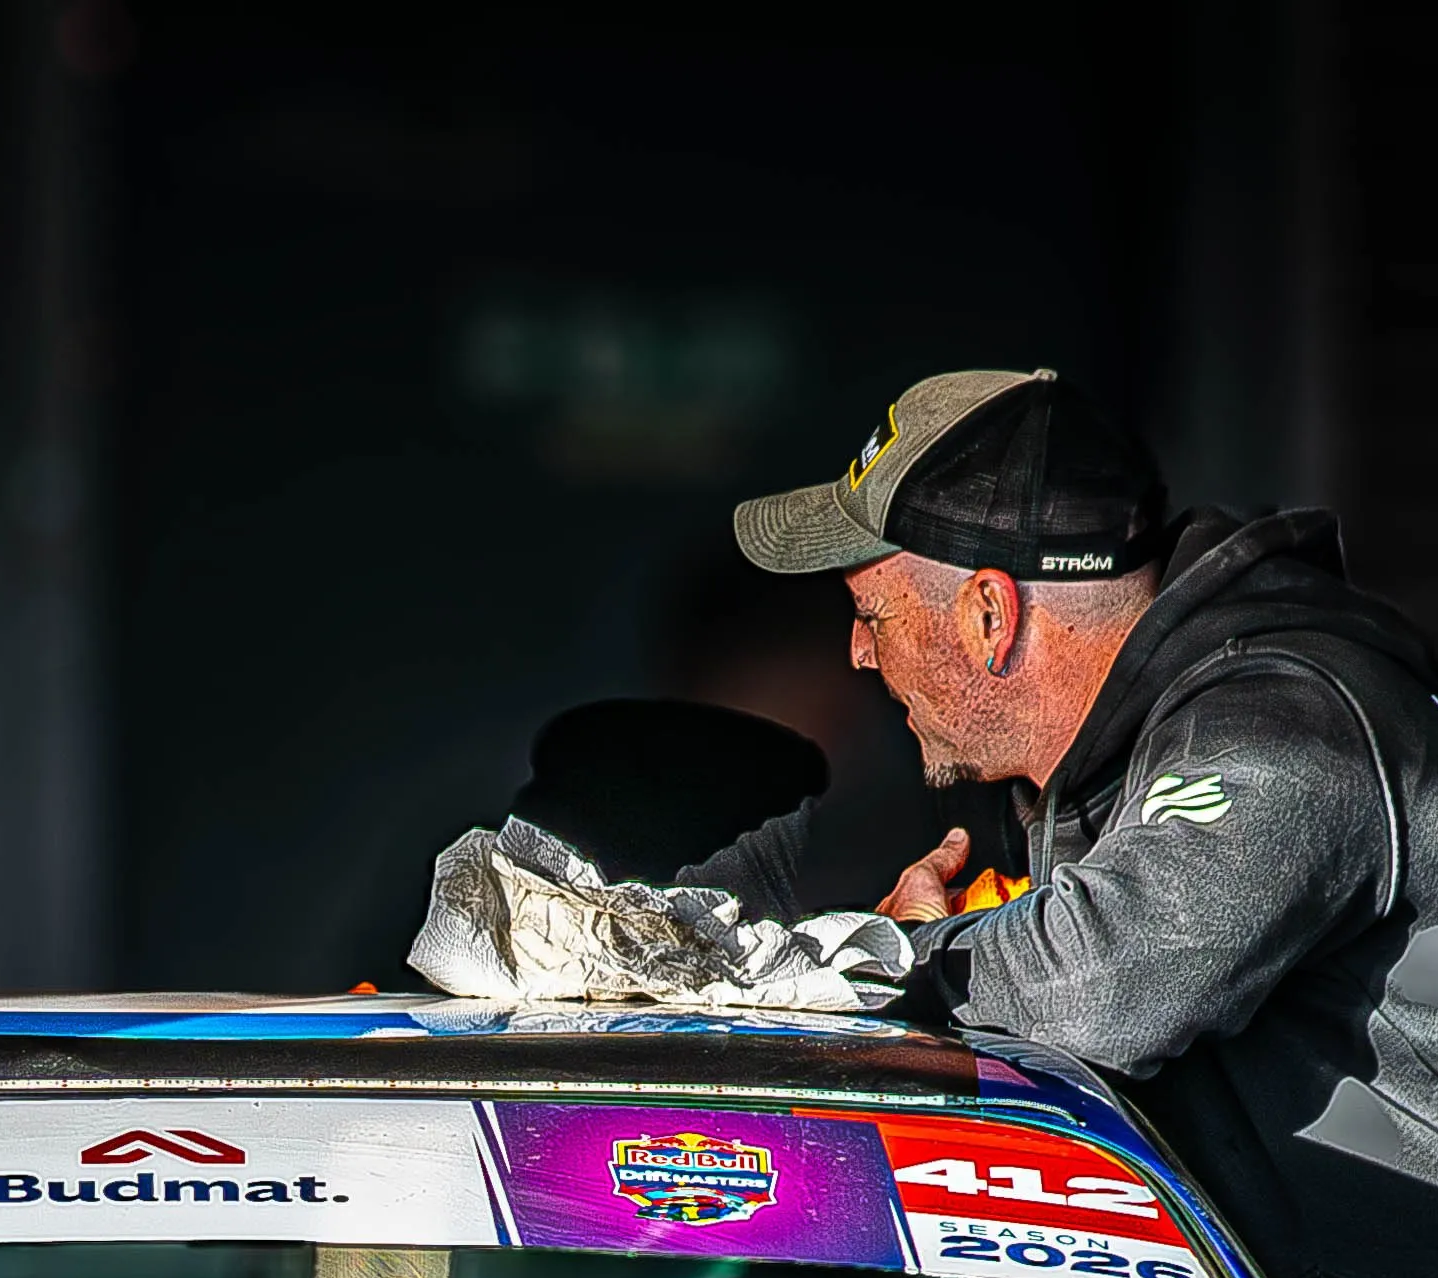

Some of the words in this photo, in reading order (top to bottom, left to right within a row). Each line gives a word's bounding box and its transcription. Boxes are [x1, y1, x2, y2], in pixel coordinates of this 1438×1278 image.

[1041, 552, 1114, 572] STRÖM
[630, 1150, 691, 1167] Red
[697, 1152, 755, 1170] Bull
[618, 1168, 672, 1183] Drift
[672, 1172, 768, 1189] MASTERS
[892, 1157, 1160, 1220] 412
[939, 1221, 1111, 1251] SEASON
